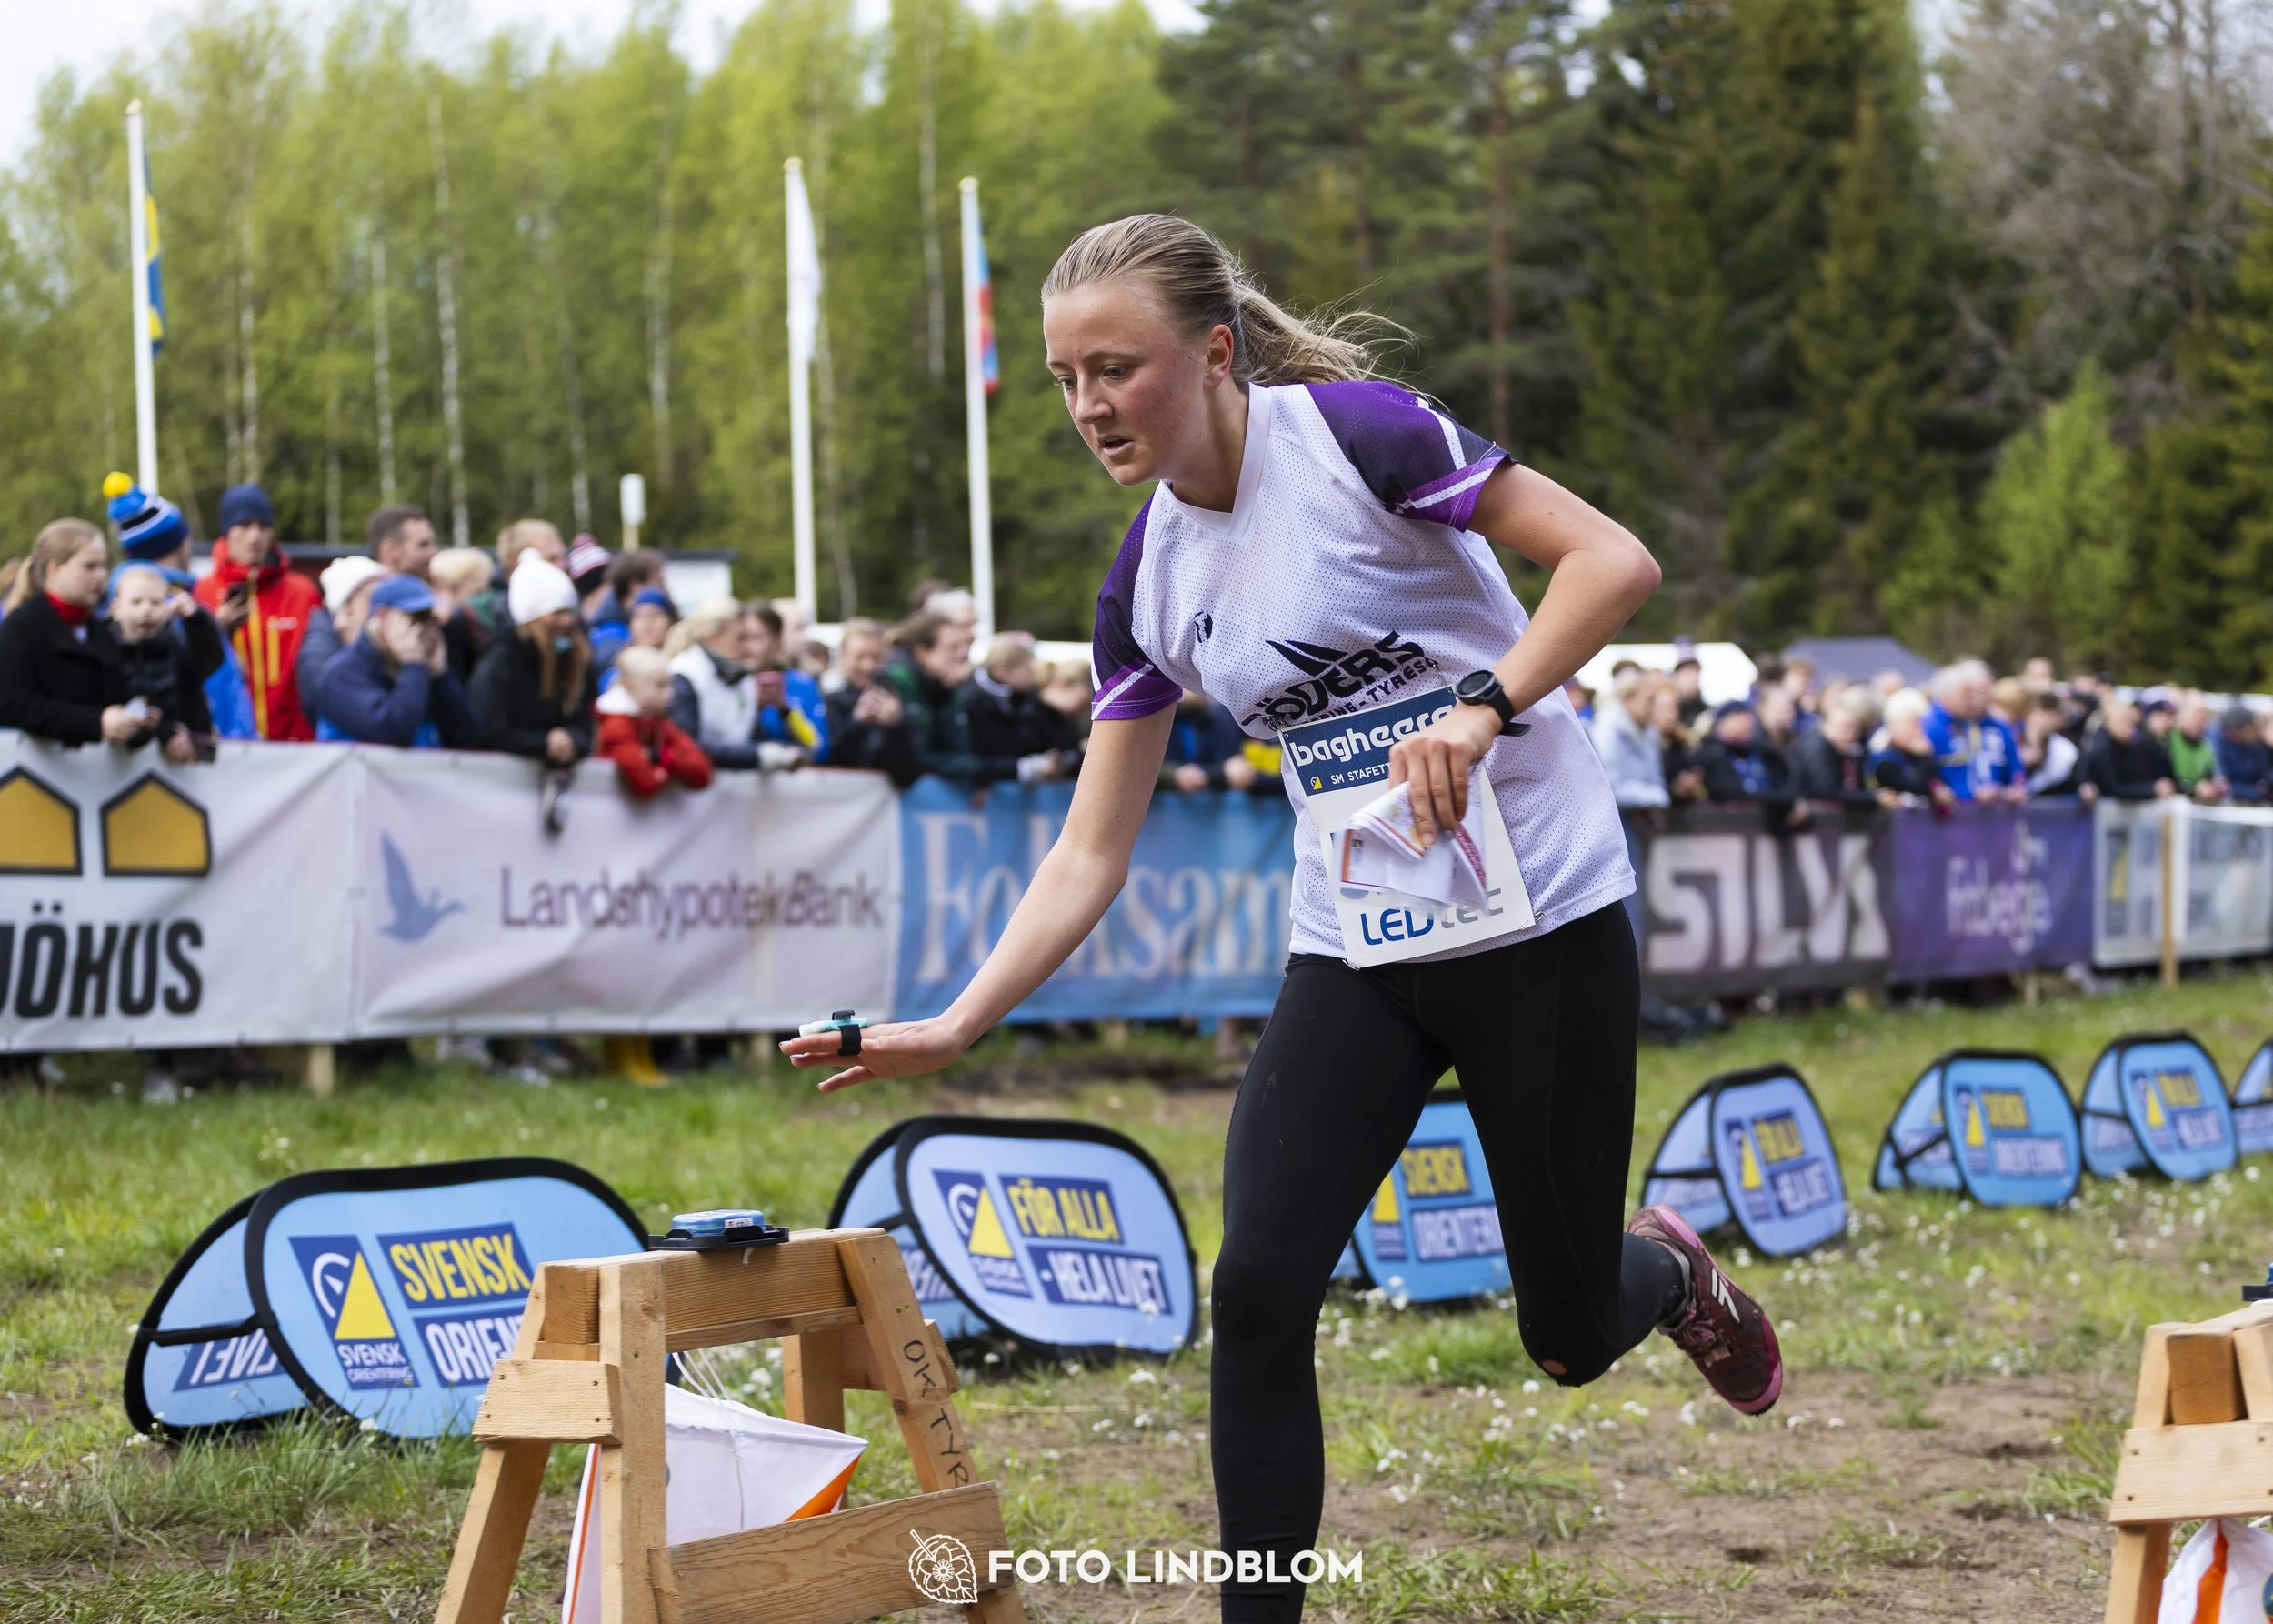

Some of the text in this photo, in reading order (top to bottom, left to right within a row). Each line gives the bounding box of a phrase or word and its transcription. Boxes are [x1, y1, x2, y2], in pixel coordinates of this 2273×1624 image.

[1330, 773, 1346, 785] SM
[1007, 1177, 1122, 1242] FÖR ALLA
[389, 1232, 533, 1302] SVENSK
[337, 1341, 407, 1368] SVENSK
[903, 1339, 937, 1398] OK
